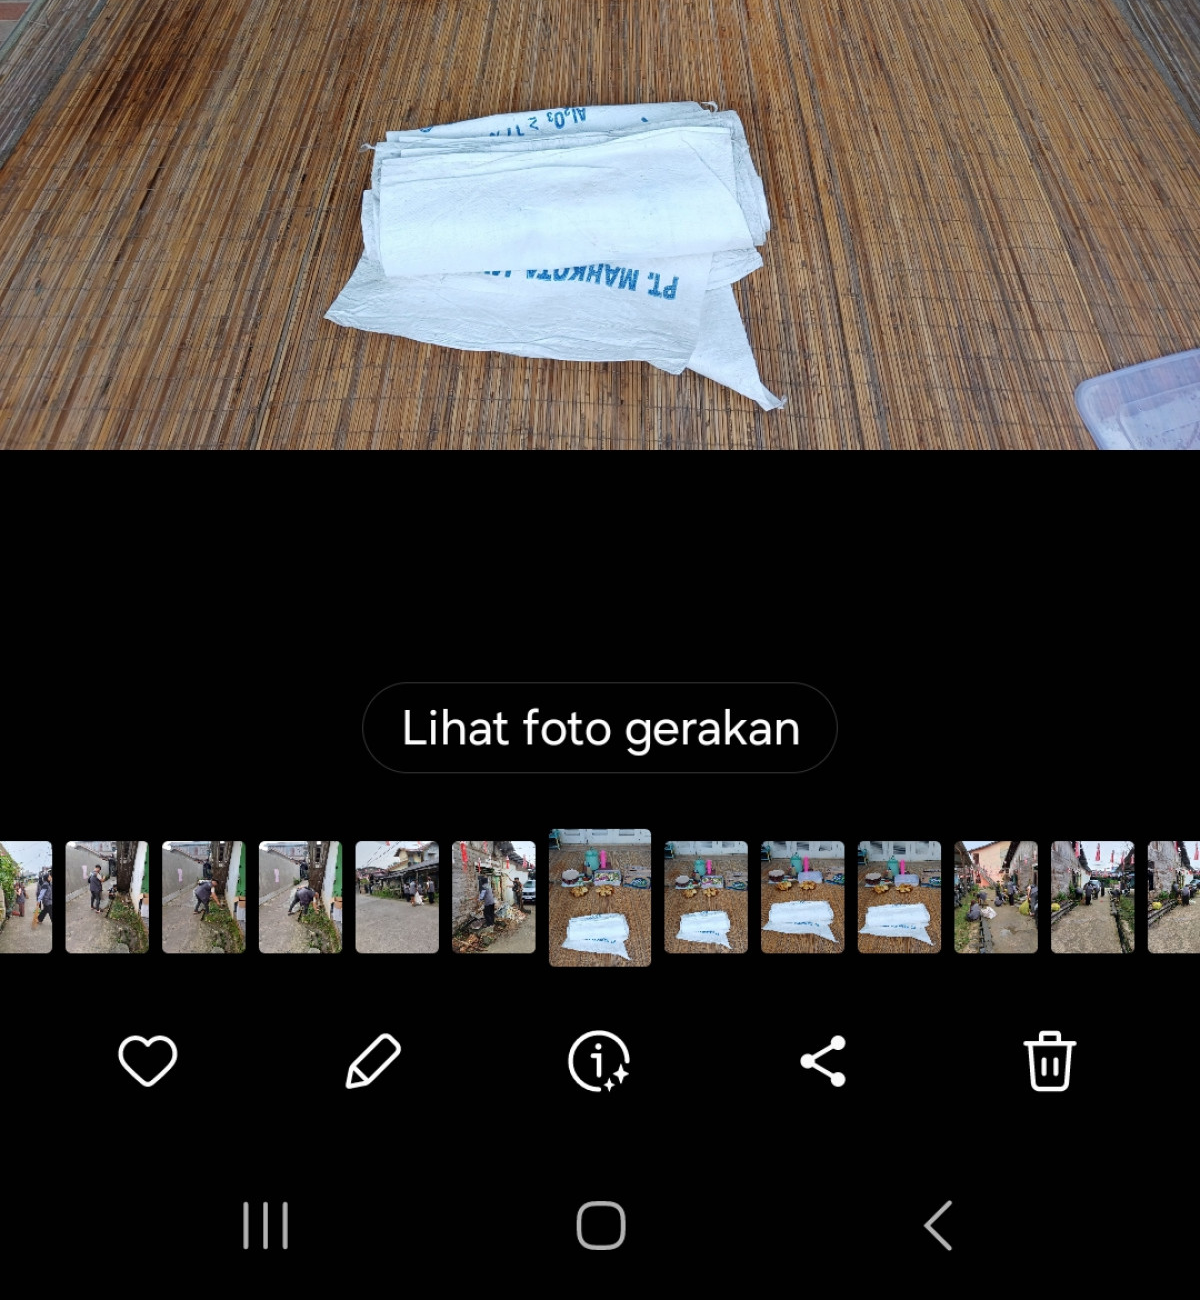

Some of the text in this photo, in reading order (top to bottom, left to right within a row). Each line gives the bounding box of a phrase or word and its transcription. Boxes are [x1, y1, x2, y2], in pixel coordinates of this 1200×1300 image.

[647, 272, 680, 300] PT.
[404, 707, 799, 757] Lihat foto gerakan
